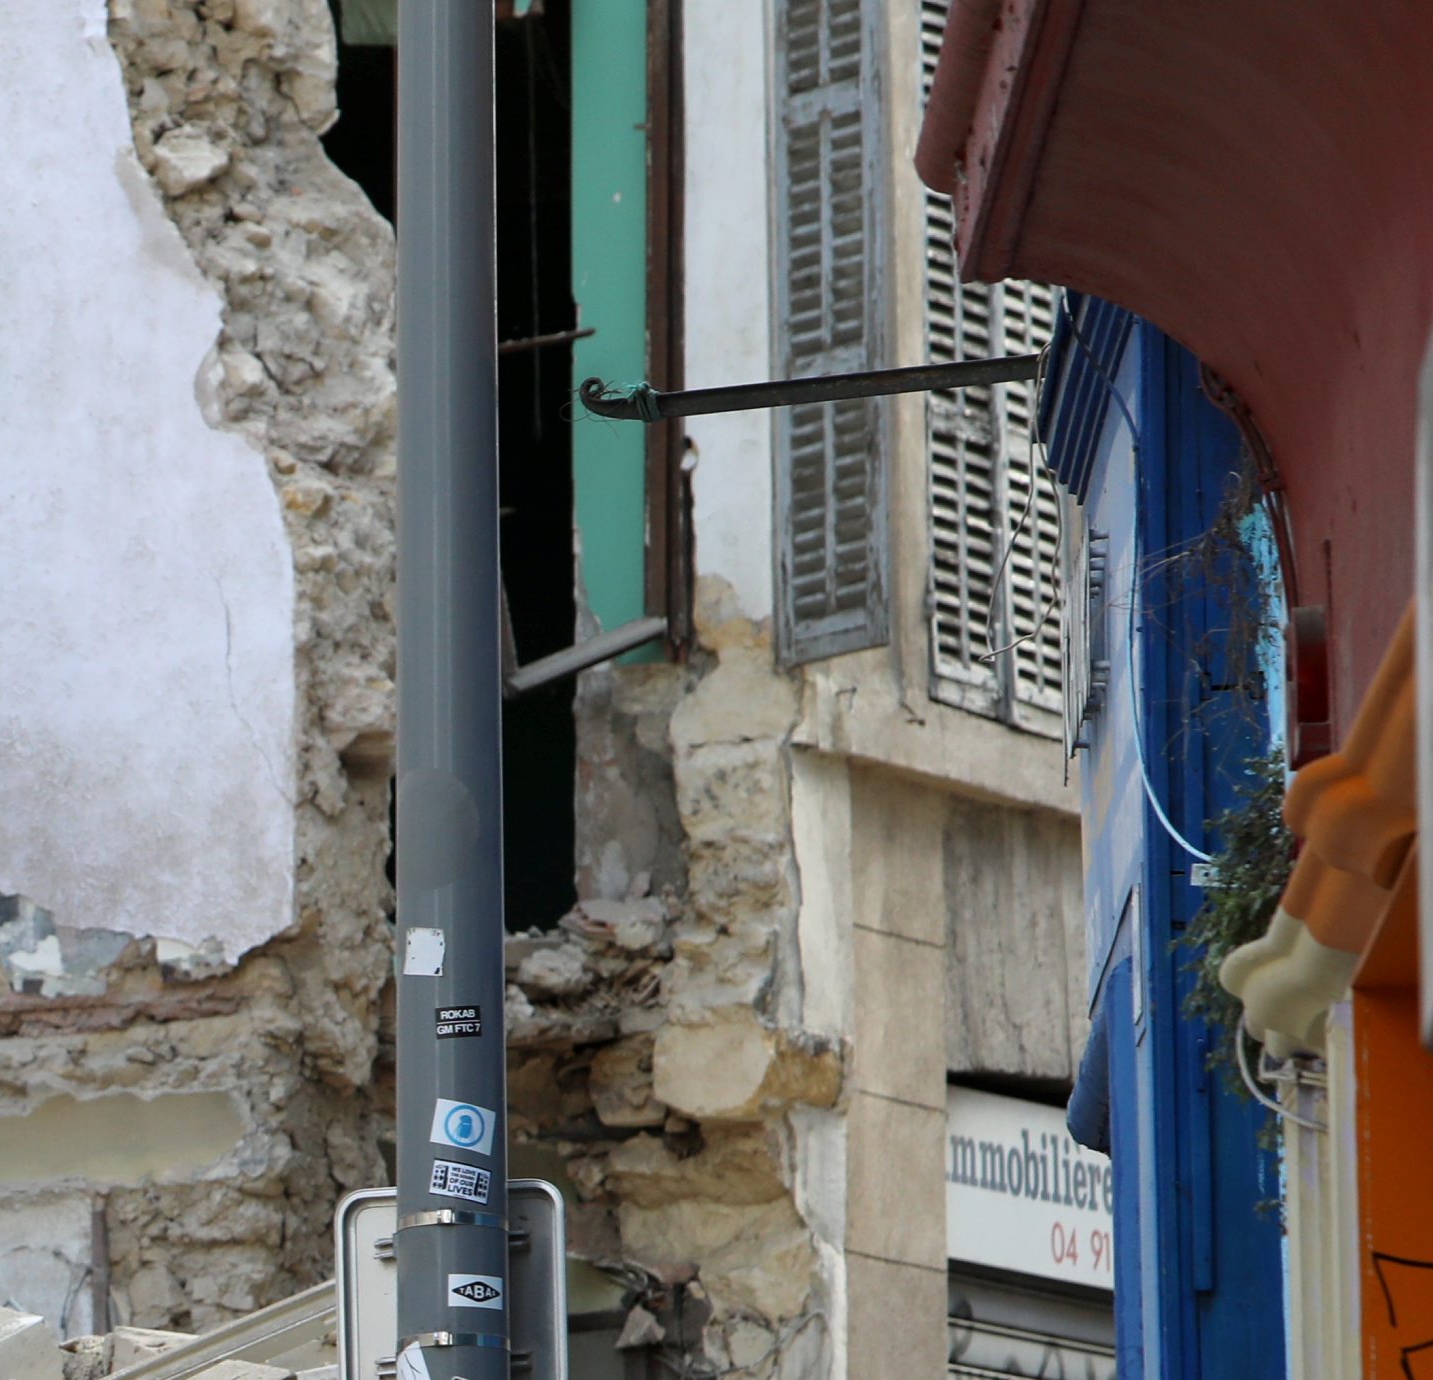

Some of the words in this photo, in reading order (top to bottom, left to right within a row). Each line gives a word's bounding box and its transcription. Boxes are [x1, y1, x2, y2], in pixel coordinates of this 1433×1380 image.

[946, 1128, 1112, 1214] mmobilière
[1051, 1221, 1078, 1266] 04
[1091, 1228, 1111, 1273] 91
